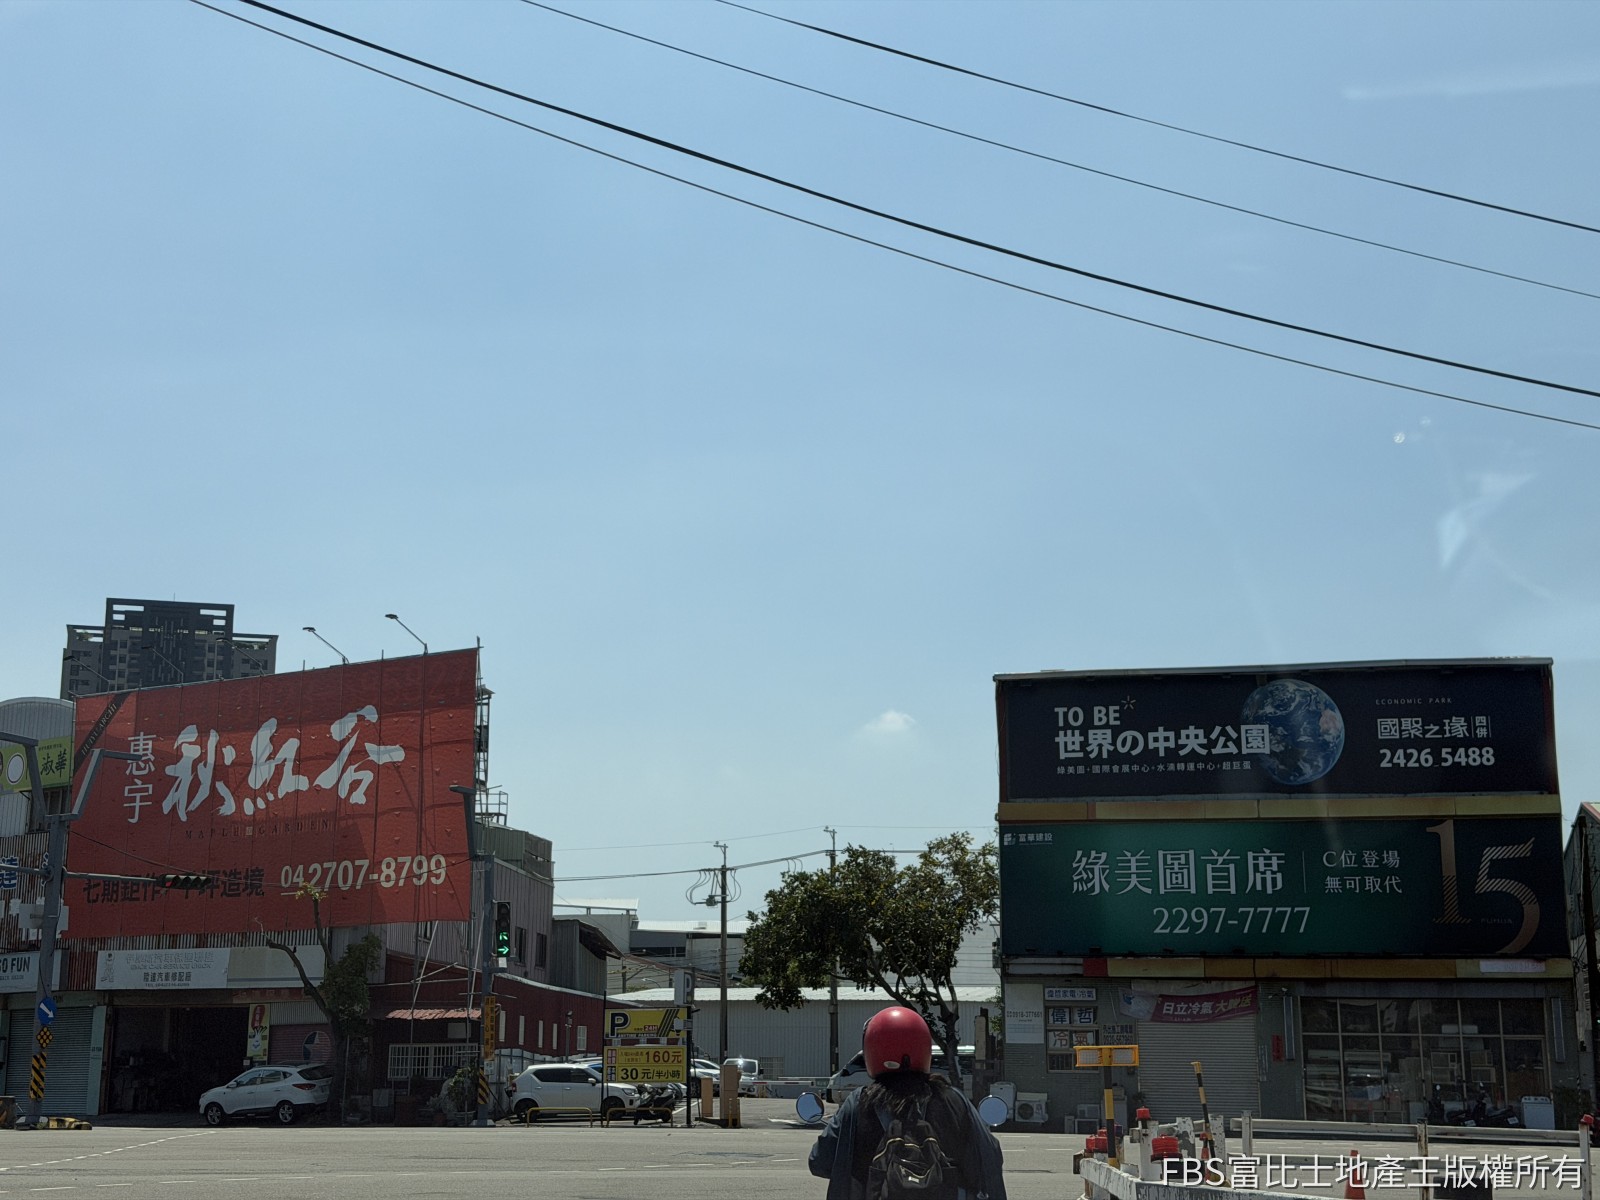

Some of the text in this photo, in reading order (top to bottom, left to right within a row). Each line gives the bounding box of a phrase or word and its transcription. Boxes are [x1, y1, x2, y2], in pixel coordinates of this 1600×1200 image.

[1375, 697, 1422, 706] ECONOMIC
[1054, 705, 1121, 727] TO BE
[1054, 724, 1271, 760] 世界の中央公園
[123, 731, 157, 824] 惠宇
[1018, 832, 1053, 842] 富華建設
[1322, 849, 1401, 869] C位登場
[308, 854, 448, 893] 2707-8799
[1072, 848, 1286, 896] 綠美圖首席
[1324, 875, 1403, 895] 無可取代
[1152, 906, 1311, 935] 2297-7777
[11, 956, 31, 973] FUN
[1050, 1007, 1092, 1025] 偉哲
[1162, 1001, 1214, 1015] 日立冷氣
[609, 1011, 631, 1037] P
[1053, 1030, 1090, 1048] 冷氣
[645, 1050, 682, 1063] 160元
